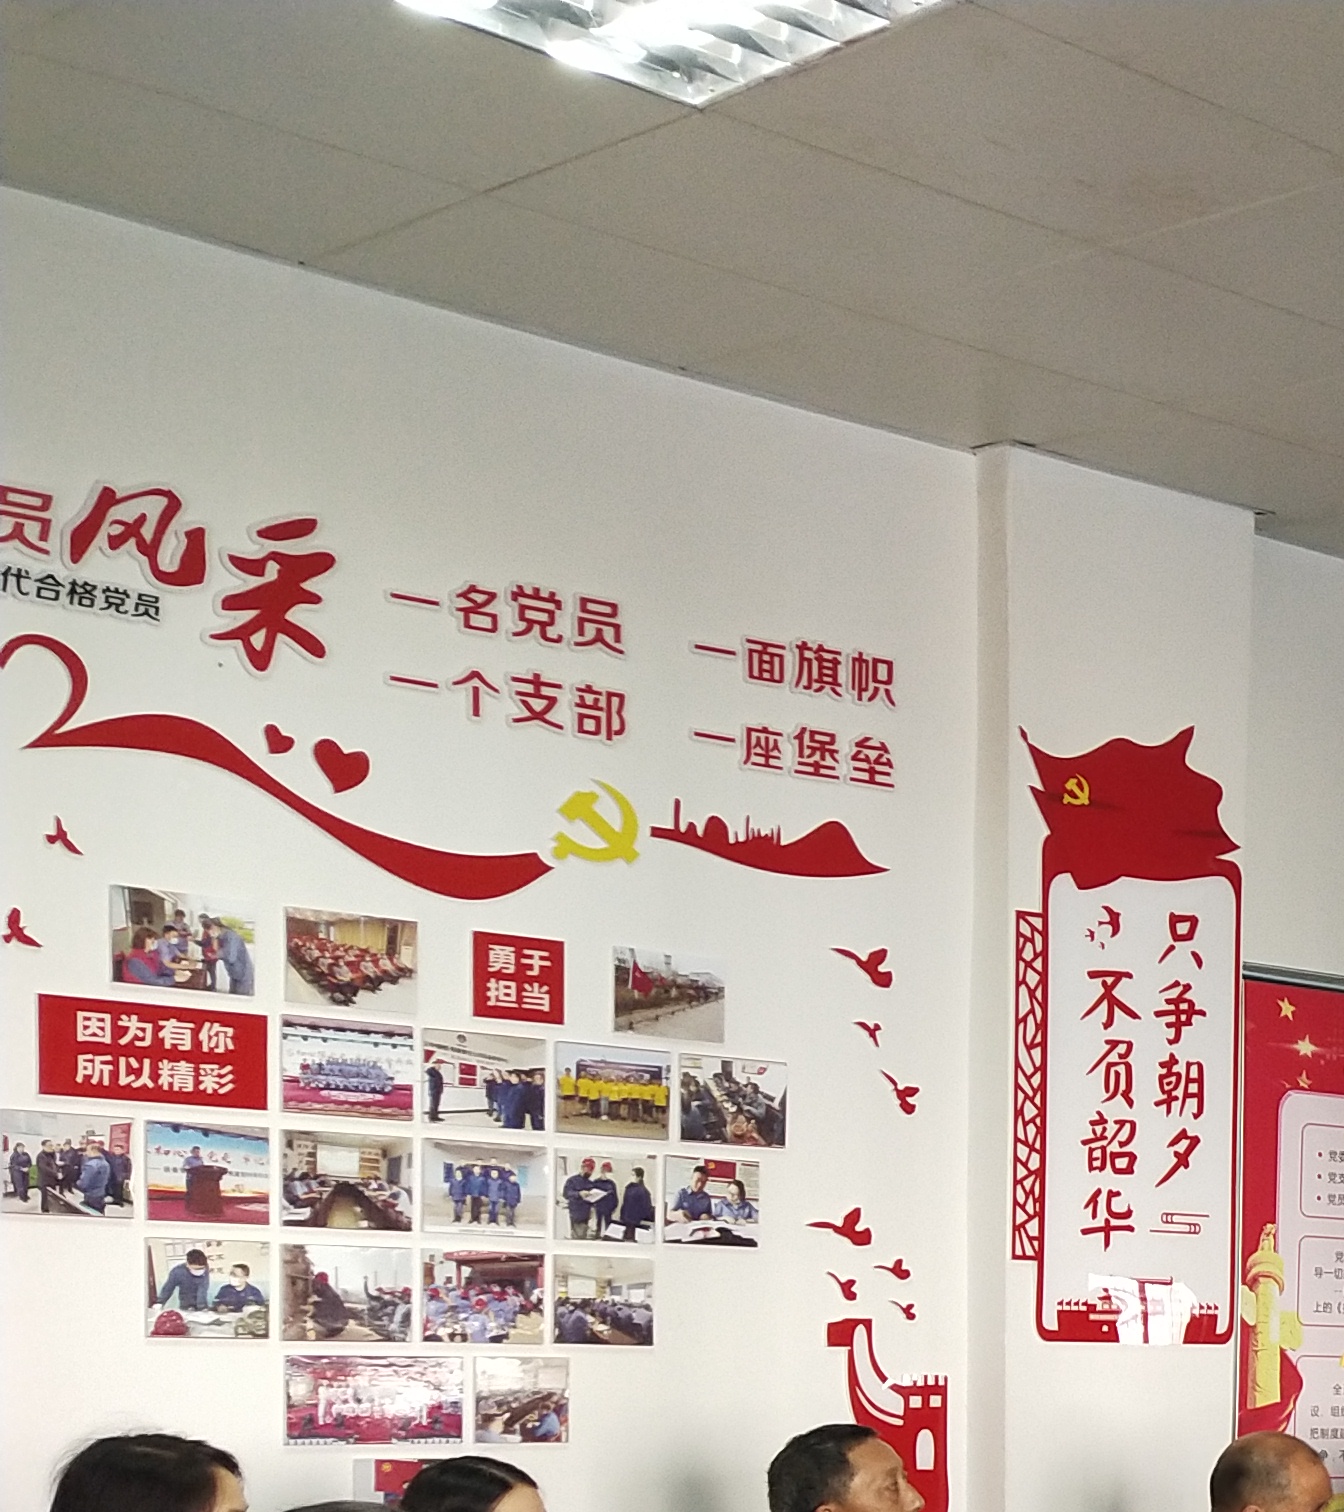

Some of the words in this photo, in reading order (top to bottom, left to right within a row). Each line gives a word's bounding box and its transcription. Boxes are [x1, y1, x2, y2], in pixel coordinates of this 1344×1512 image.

[1, 565, 161, 622] 代合格党员
[390, 585, 625, 655] 一名党员
[693, 637, 898, 707] 一面旗帜
[388, 667, 627, 742] 一个支部
[693, 725, 897, 789] 一座堡垒
[486, 944, 553, 979] 勇于
[486, 977, 553, 1013] 担当
[75, 1009, 234, 1054] 因为有你
[1152, 910, 1207, 1188] 只争朝夕
[75, 1053, 234, 1095] 所以精彩
[1080, 969, 1142, 1252] 不负韶华
